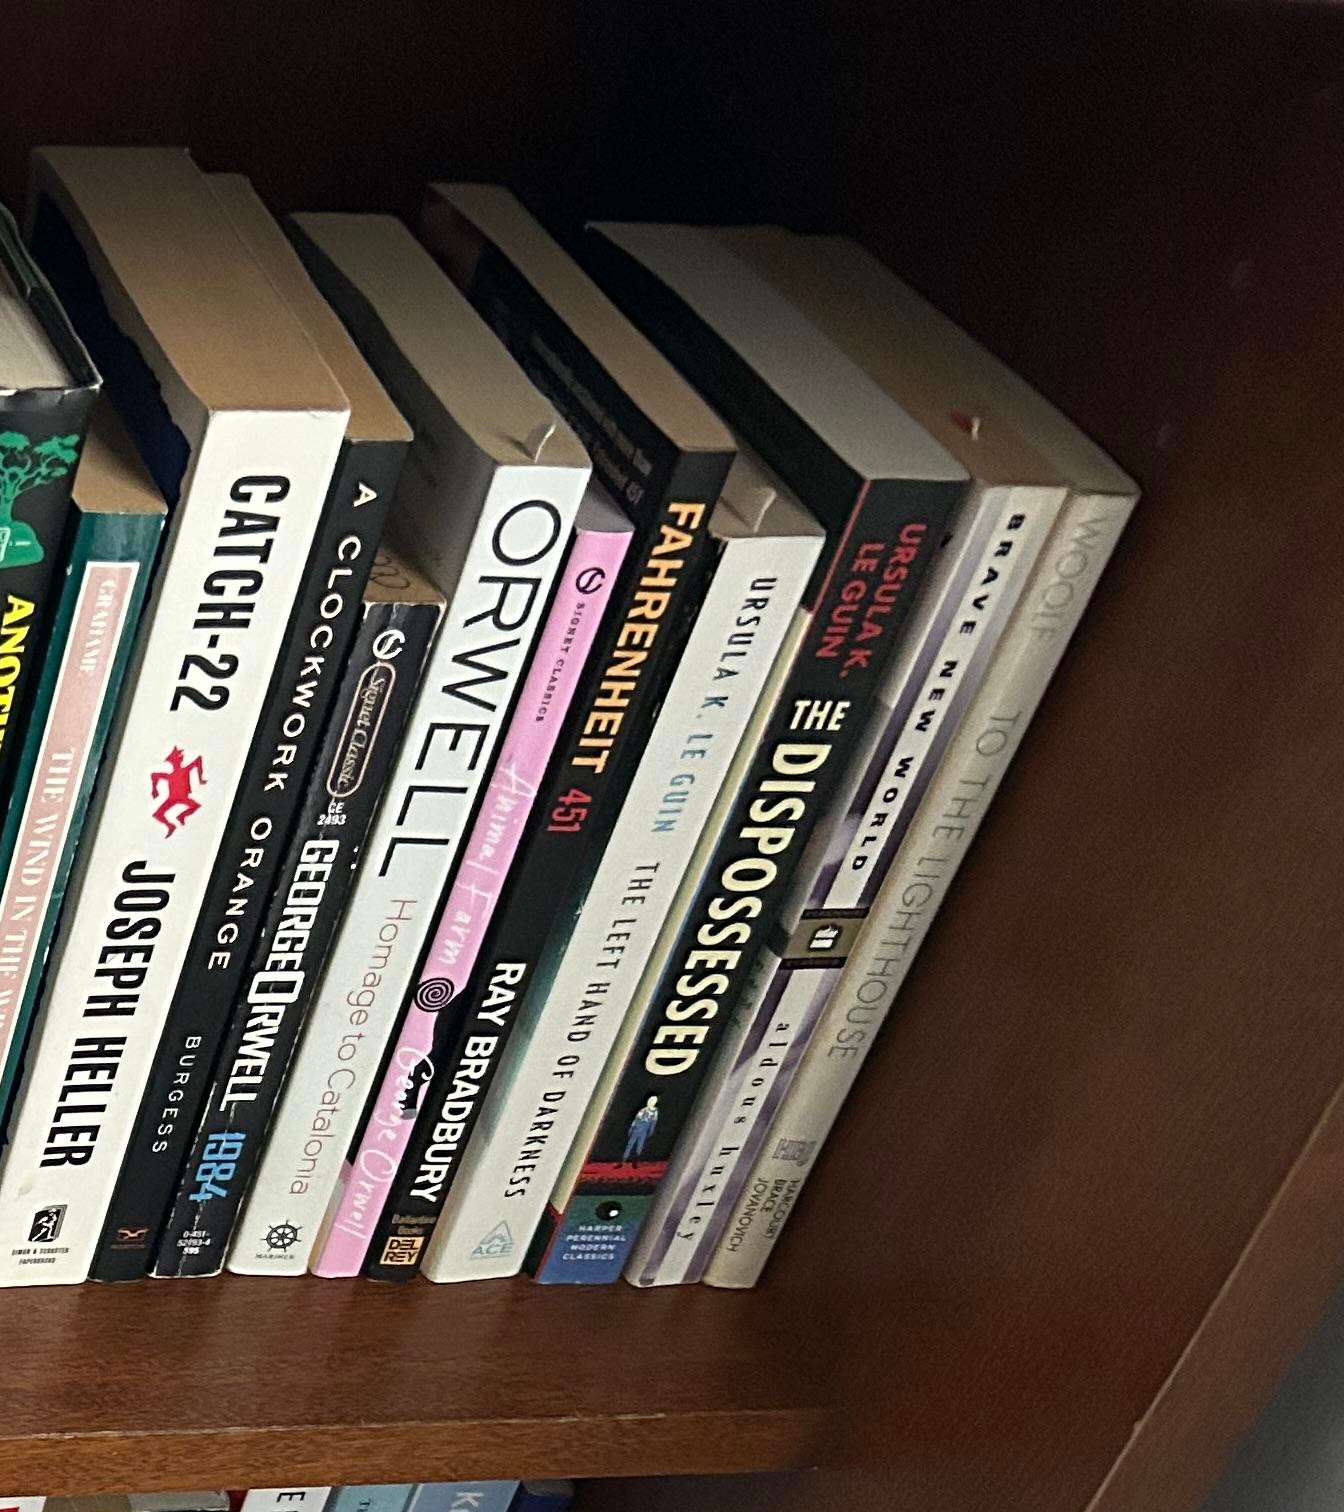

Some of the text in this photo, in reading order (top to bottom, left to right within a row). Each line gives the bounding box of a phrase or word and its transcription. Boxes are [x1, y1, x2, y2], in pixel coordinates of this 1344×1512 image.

[168, 474, 291, 714] CATCH-22
[378, 499, 562, 878] ORWELL
[546, 502, 706, 833] FAHRENHEIT 451
[789, 700, 851, 732] THE
[851, 514, 1025, 872] BRAVE NEW WORLD
[82, 860, 176, 1019] JOSEPH
[643, 743, 835, 1076] DISPOSSESSED
[39, 1036, 128, 1169] HELLER
[288, 899, 417, 1197] Homage to Catalonia
[410, 962, 527, 1203] RAY BRADBURY
